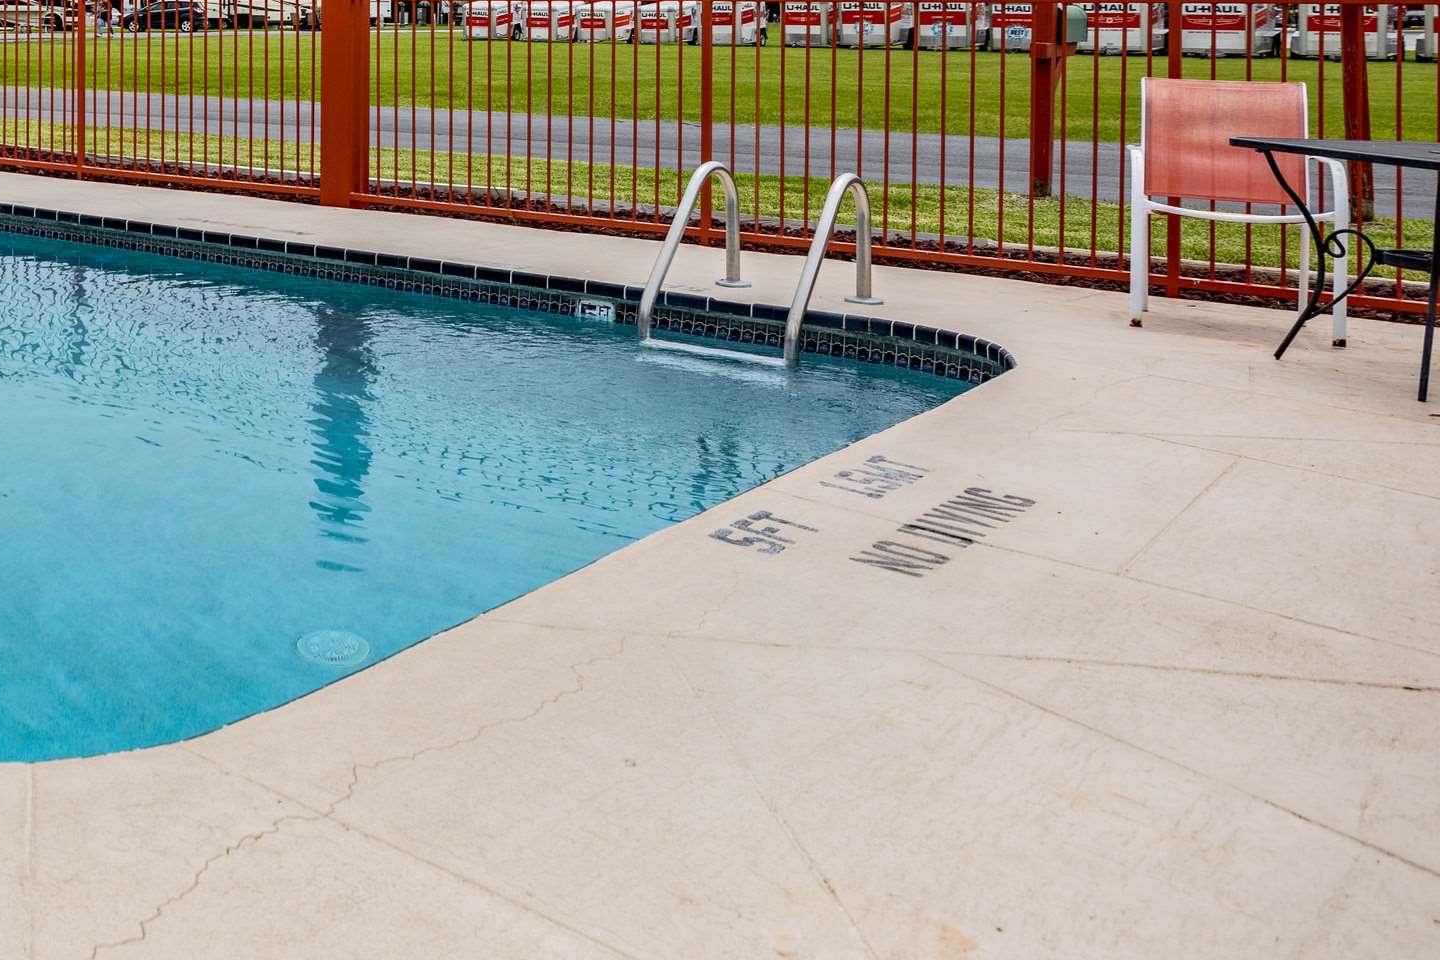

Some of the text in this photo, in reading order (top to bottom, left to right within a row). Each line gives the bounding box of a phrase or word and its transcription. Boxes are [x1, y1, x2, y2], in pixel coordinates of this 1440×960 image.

[708, 510, 819, 555] 5FT
[849, 486, 1037, 578] NO DIVING
